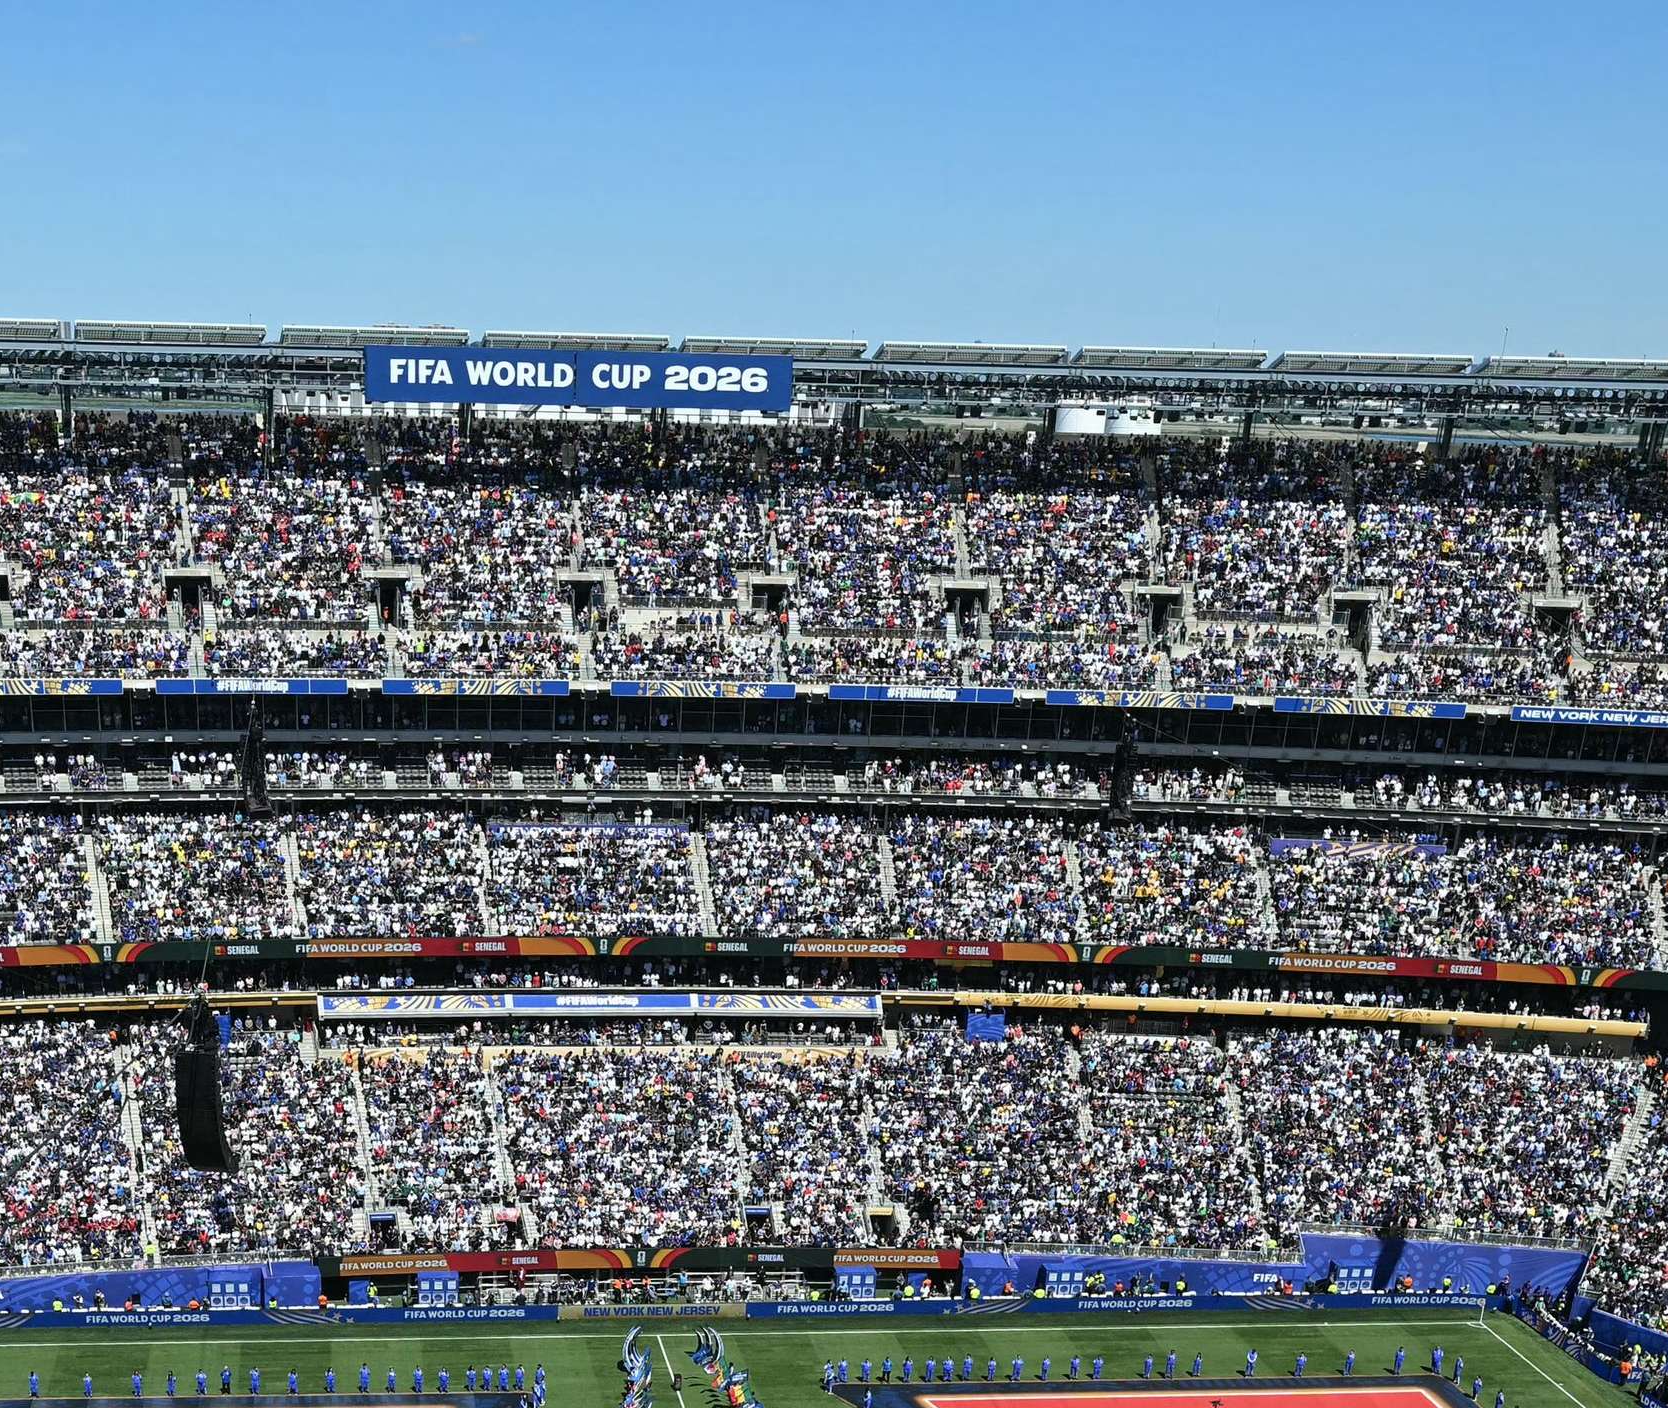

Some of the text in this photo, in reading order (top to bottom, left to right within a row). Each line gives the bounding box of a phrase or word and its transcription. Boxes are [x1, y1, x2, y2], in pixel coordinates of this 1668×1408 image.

[390, 358, 768, 392] FIFA WORLD CUP 2026
[1520, 709, 1554, 719] NEW
[1559, 711, 1599, 720] YORK
[1603, 713, 1638, 722] NEW
[227, 945, 260, 955] SENEGAL
[295, 942, 422, 953] FIFA WORLD CUP 2026
[475, 942, 506, 952] SENEGAL
[717, 943, 748, 951] SENEGAL
[783, 943, 907, 953] FIFA WORLD CUP 2026
[958, 946, 989, 955] SENEGAL
[1201, 954, 1232, 964] SENEGAL
[1269, 957, 1396, 971] FIFA WORLD CUP 2026
[1450, 965, 1482, 975] SENEGAL
[757, 1254, 784, 1262] SENEGAL
[853, 1254, 885, 1263] WORLD
[886, 1255, 906, 1263] CUP
[907, 1255, 939, 1263] 2026
[339, 1260, 447, 1271] FIFA WORLD CUP 2026
[1253, 1273, 1278, 1282] FIFA
[1078, 1299, 1192, 1309] FIFA WORLD CUP 2026
[1393, 1296, 1429, 1304] WORLD
[1430, 1296, 1450, 1304] CUP
[584, 1306, 721, 1317] NEW YORK NEW JERSEY
[777, 1303, 894, 1313] FIFA WORLD CUP 2026
[86, 1314, 210, 1323] FIFA WORLD CUP 2026
[404, 1309, 525, 1319] FIFA WORLD CUP 2026
